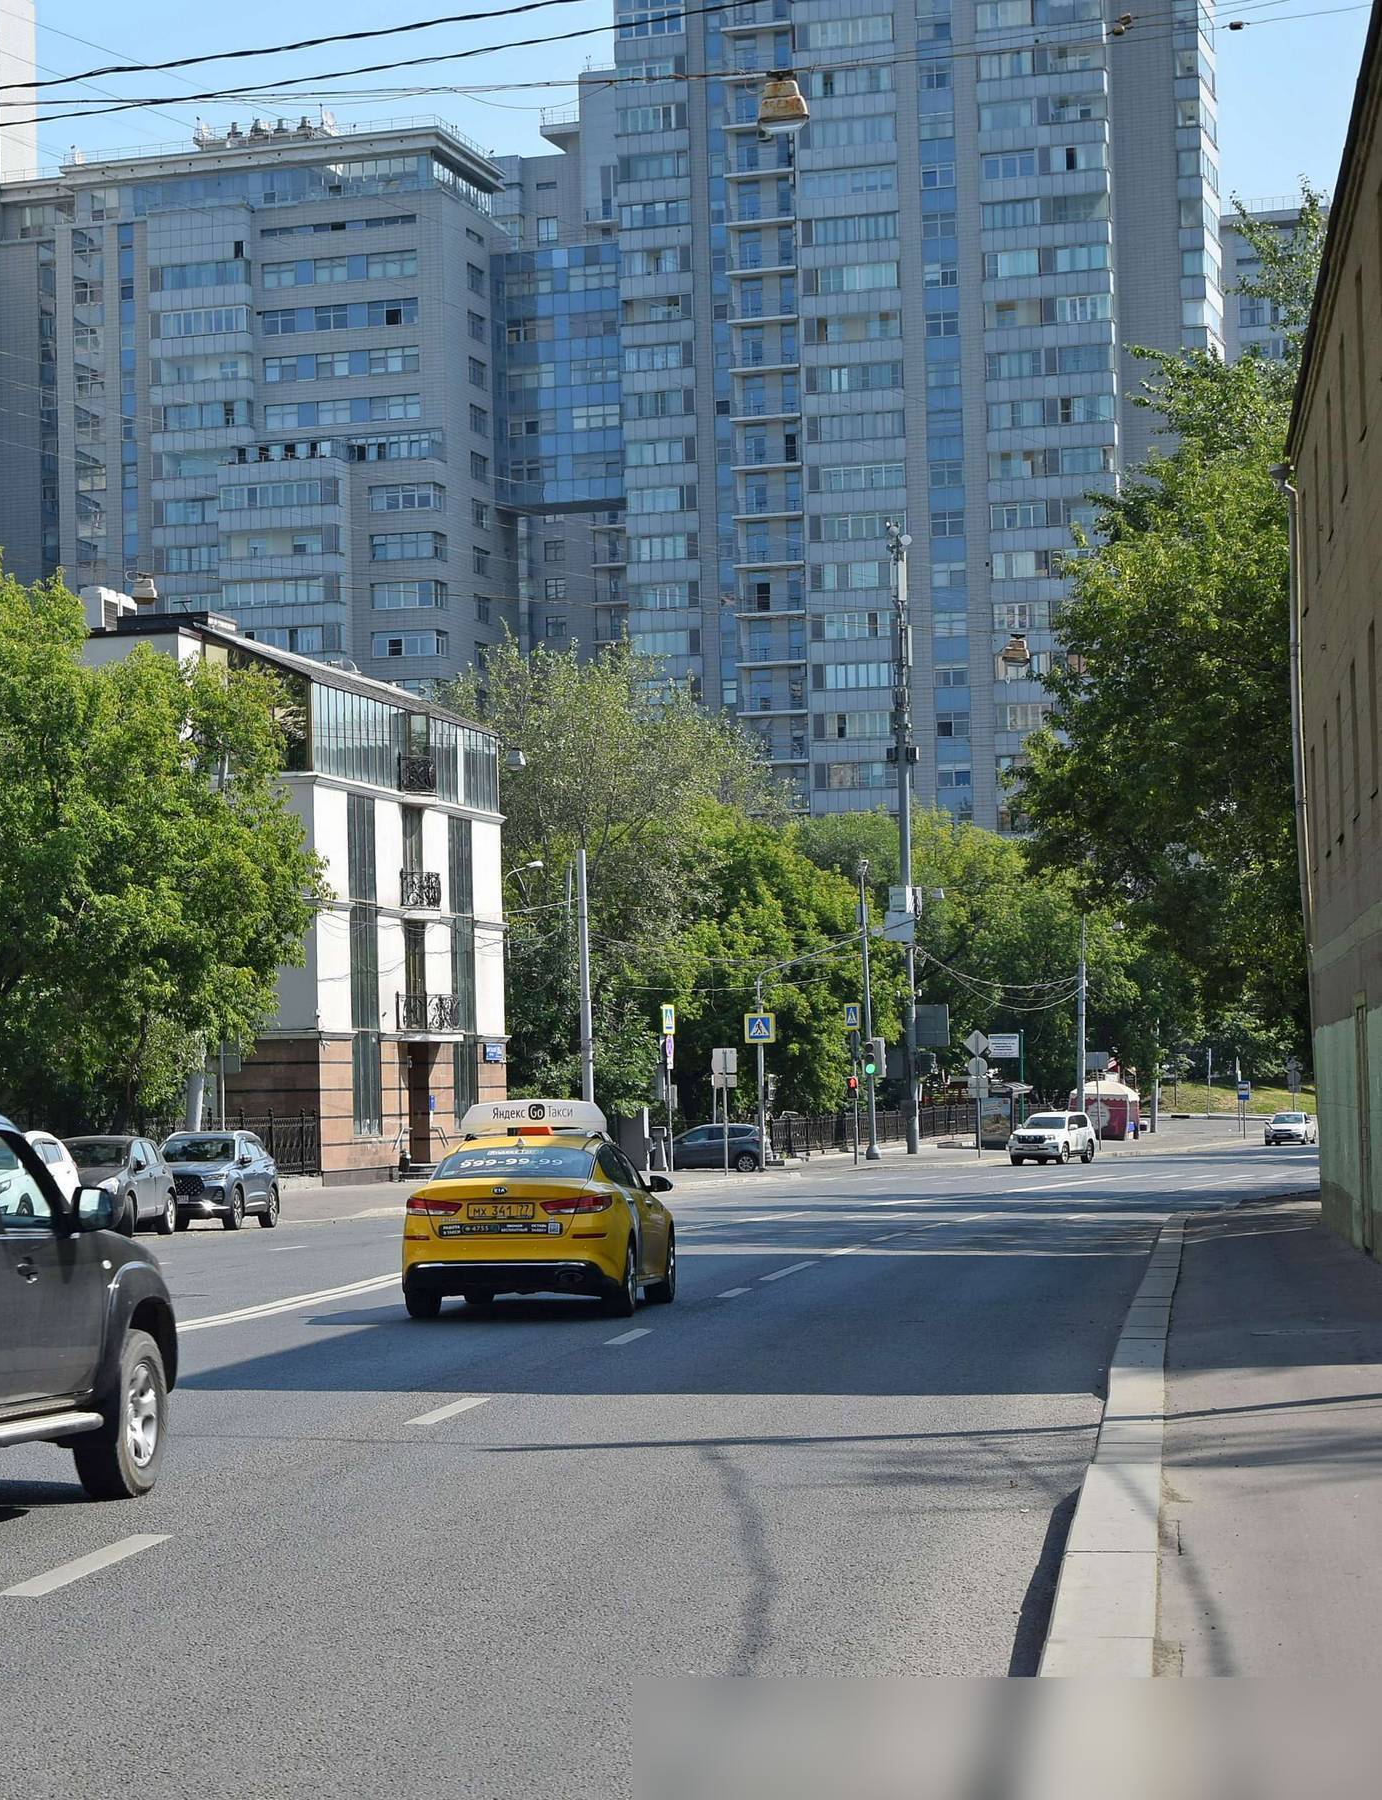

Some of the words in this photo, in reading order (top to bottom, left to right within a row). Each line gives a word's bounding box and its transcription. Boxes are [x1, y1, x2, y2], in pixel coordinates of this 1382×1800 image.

[492, 1107, 526, 1120] Яндекс
[529, 1104, 544, 1119] Go
[547, 1105, 574, 1118] Такси
[492, 1205, 512, 1216] 341
